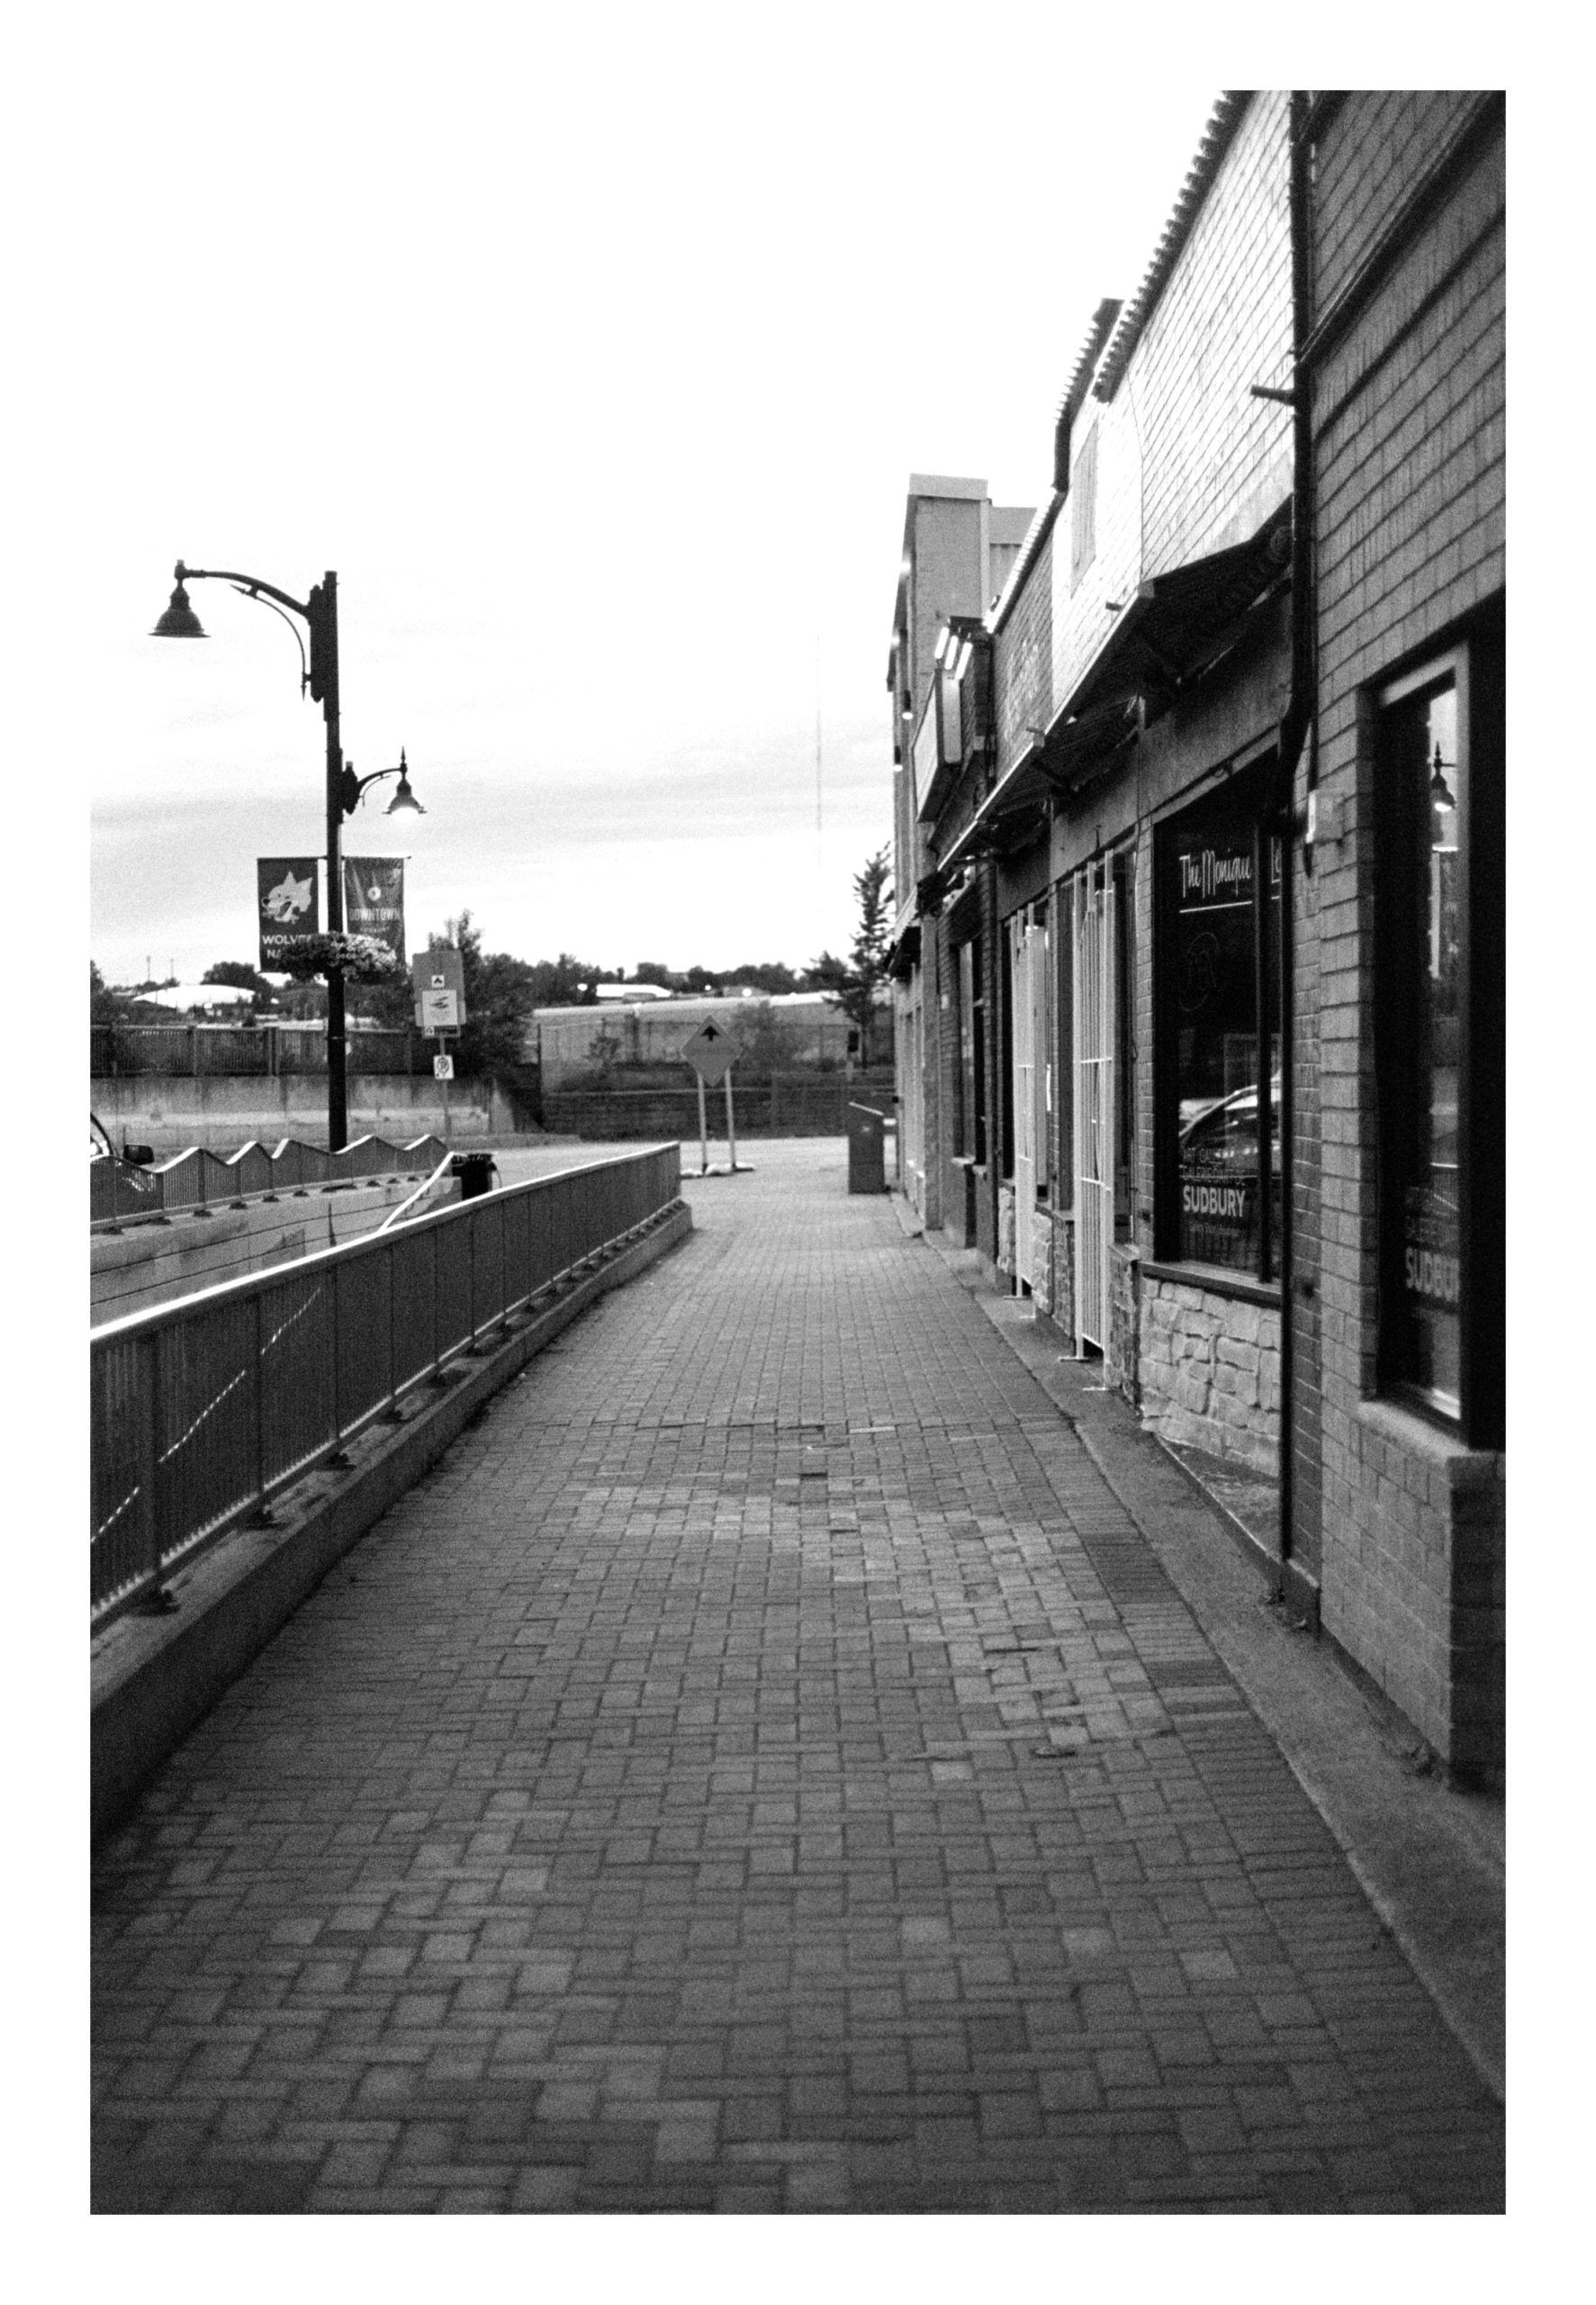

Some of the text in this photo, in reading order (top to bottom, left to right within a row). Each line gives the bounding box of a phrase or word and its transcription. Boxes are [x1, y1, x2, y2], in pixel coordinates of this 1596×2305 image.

[1179, 846, 1252, 898] The Monique
[349, 908, 400, 921] DOWNTOWN
[1183, 1185, 1245, 1216] SUDBURY
